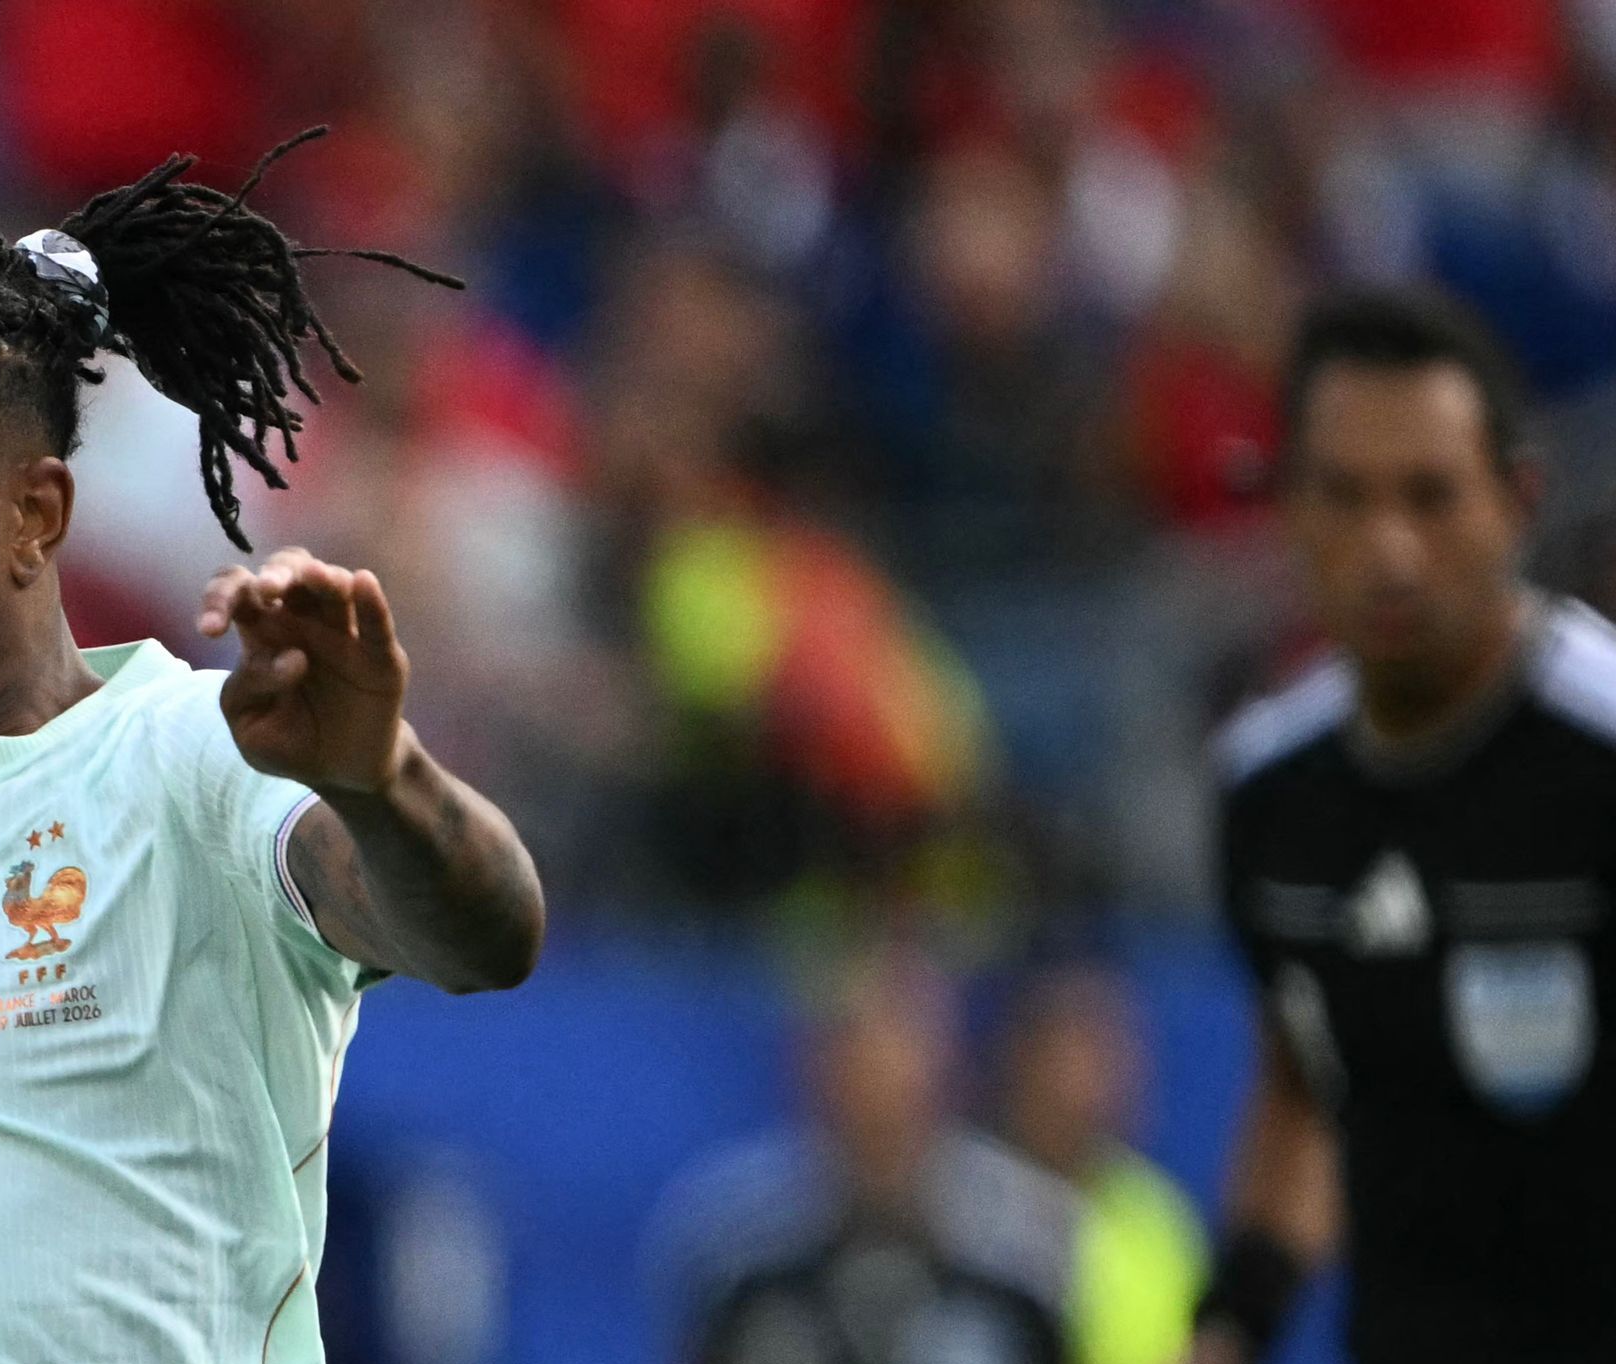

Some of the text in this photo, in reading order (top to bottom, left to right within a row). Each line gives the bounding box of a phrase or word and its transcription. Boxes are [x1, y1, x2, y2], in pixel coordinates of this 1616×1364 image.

[50, 985, 97, 1006] MAROC
[14, 1008, 57, 1029] JUILLET
[61, 1003, 103, 1023] 2026
